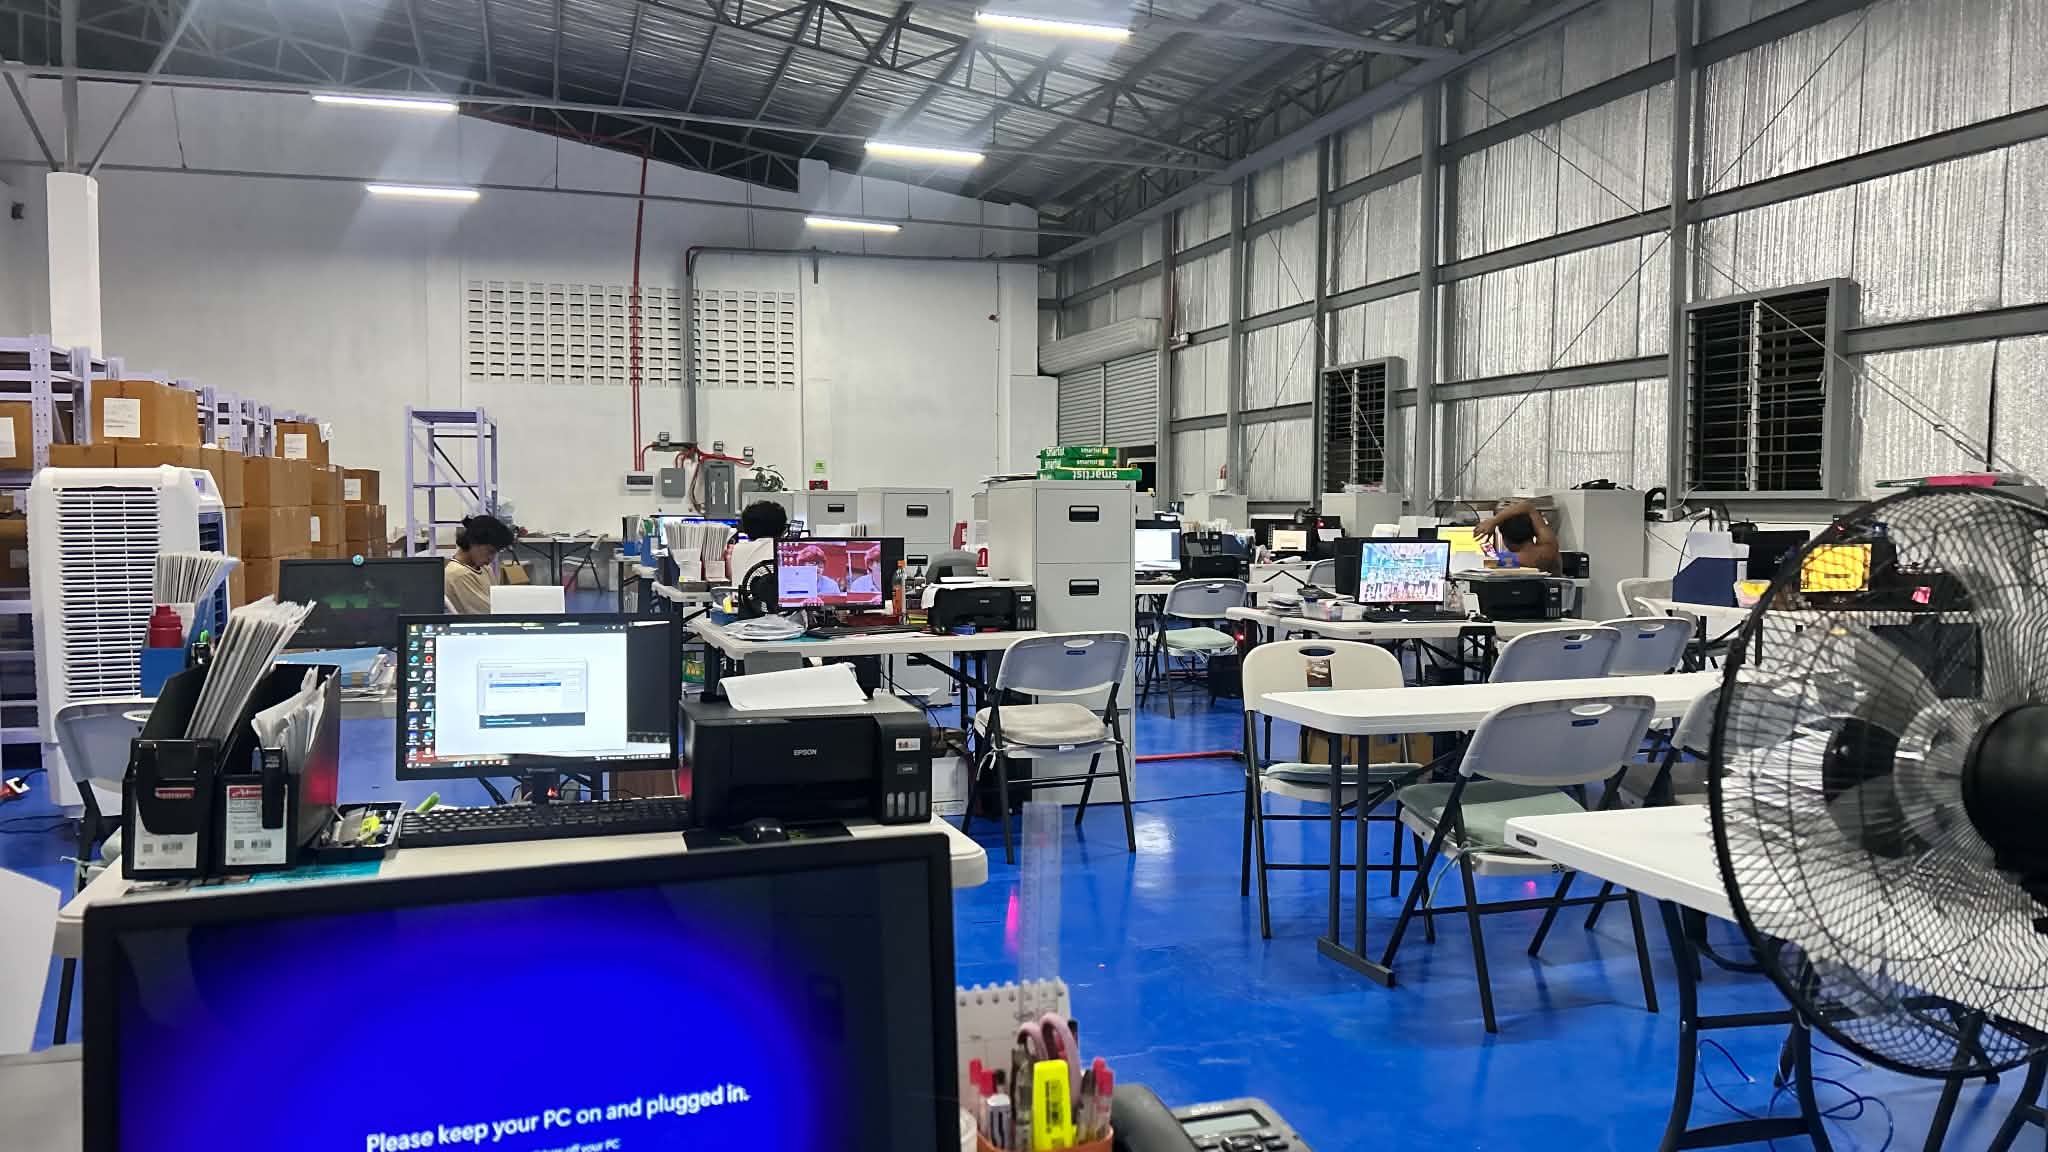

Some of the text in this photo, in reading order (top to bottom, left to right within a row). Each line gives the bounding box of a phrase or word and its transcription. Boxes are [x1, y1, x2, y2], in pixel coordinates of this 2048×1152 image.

[1072, 470, 1118, 480] smartist
[366, 1083, 751, 1152] Please keep your PC on and plugged in.
[605, 1138, 621, 1150] PC
